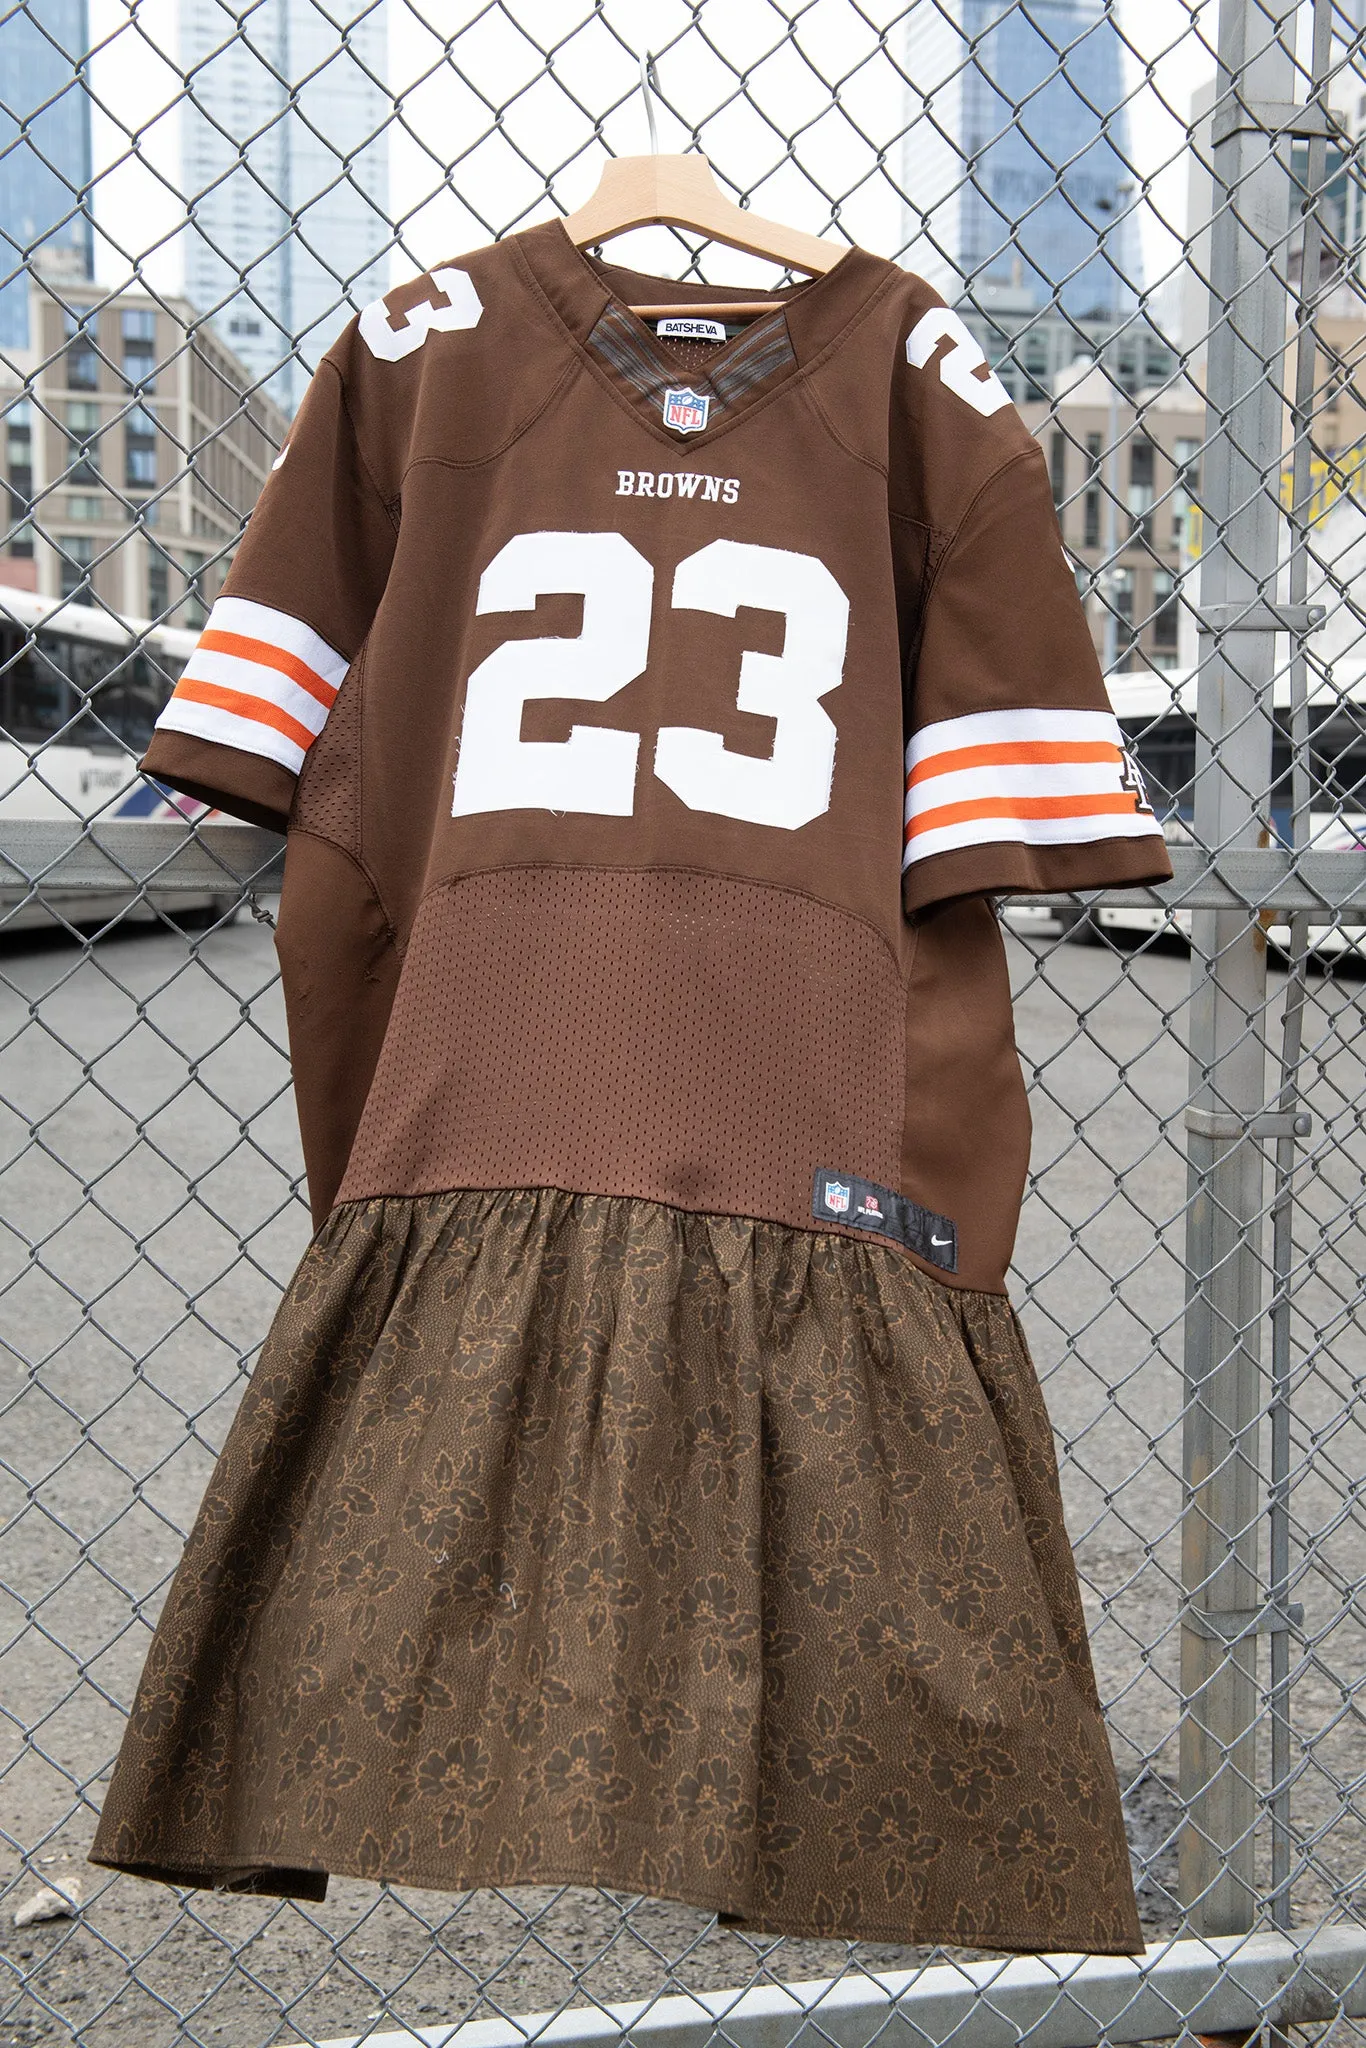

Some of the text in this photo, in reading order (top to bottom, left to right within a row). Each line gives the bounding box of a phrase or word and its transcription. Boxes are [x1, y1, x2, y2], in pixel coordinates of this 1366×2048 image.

[665, 323, 718, 336] BATSHEVA
[670, 405, 700, 426] NFL
[615, 470, 740, 503] BROWNS
[452, 531, 850, 830] 23
[829, 1194, 846, 1209] NFL
